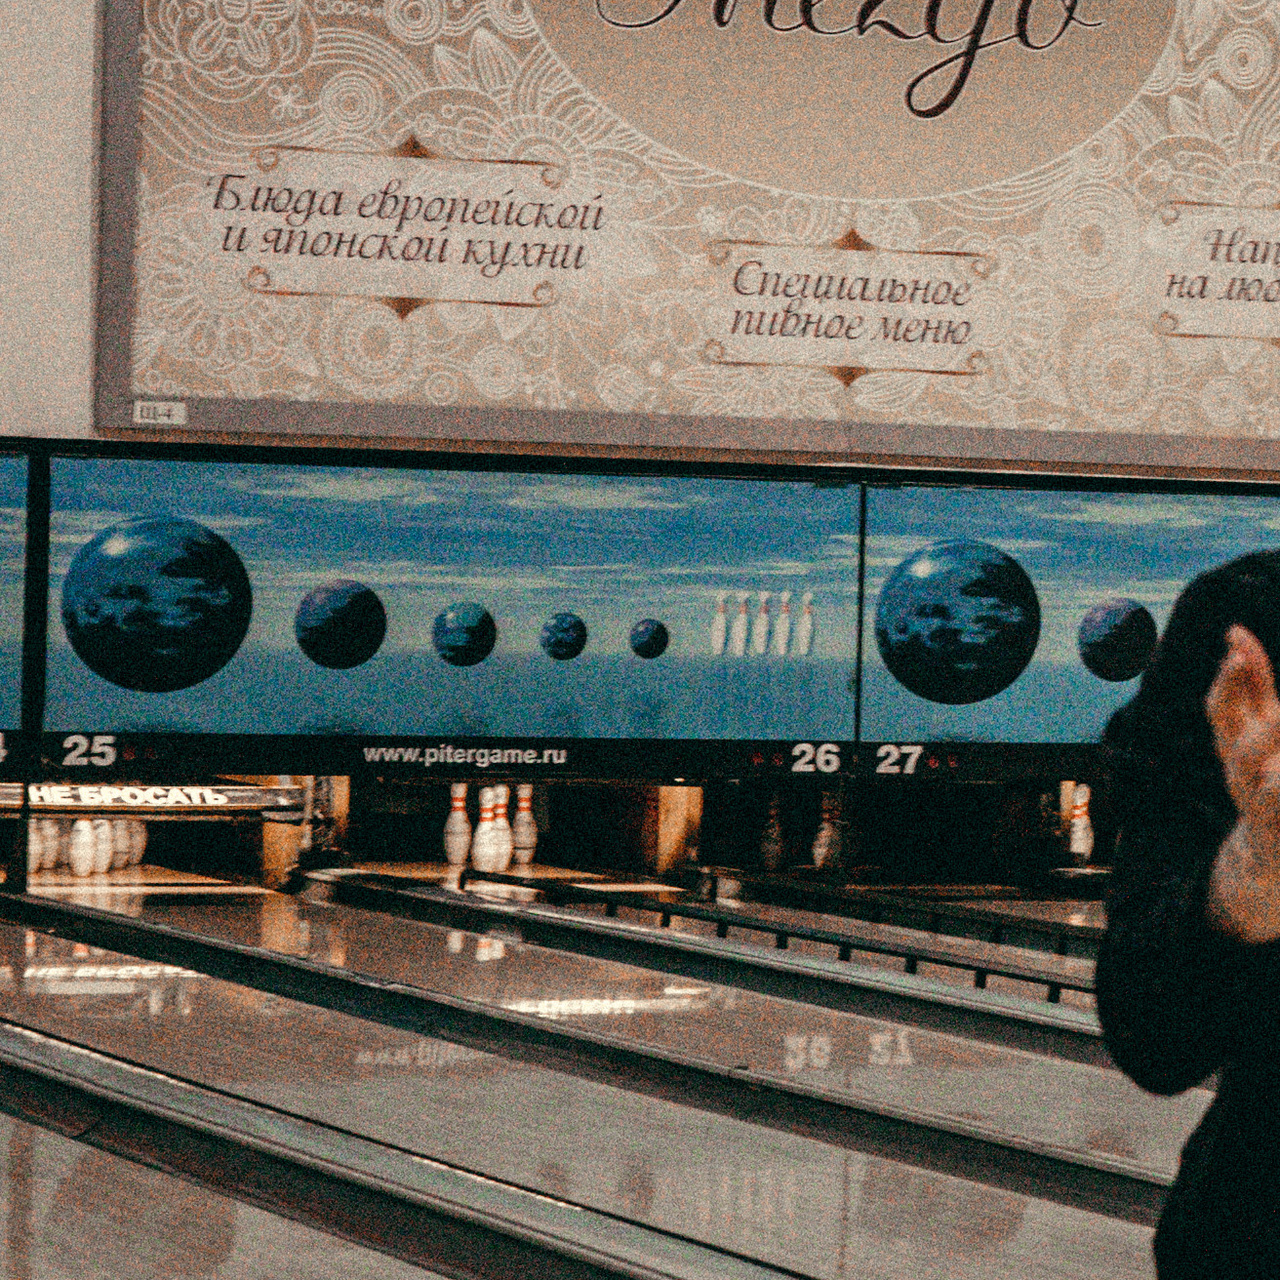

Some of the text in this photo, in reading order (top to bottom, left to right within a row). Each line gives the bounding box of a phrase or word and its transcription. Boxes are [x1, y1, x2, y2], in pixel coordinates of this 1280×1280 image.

[206, 172, 606, 234] Блюда европейской
[220, 223, 589, 279] и японской кухни
[732, 260, 974, 307] Специальное
[1164, 272, 1209, 300] на
[729, 293, 972, 346] пивное меню
[61, 734, 117, 767] 25
[362, 743, 568, 768] www.pitergame.ru
[791, 743, 841, 774] 26
[875, 744, 924, 775] 27
[28, 785, 229, 806] НЕ БРОСАТЬ
